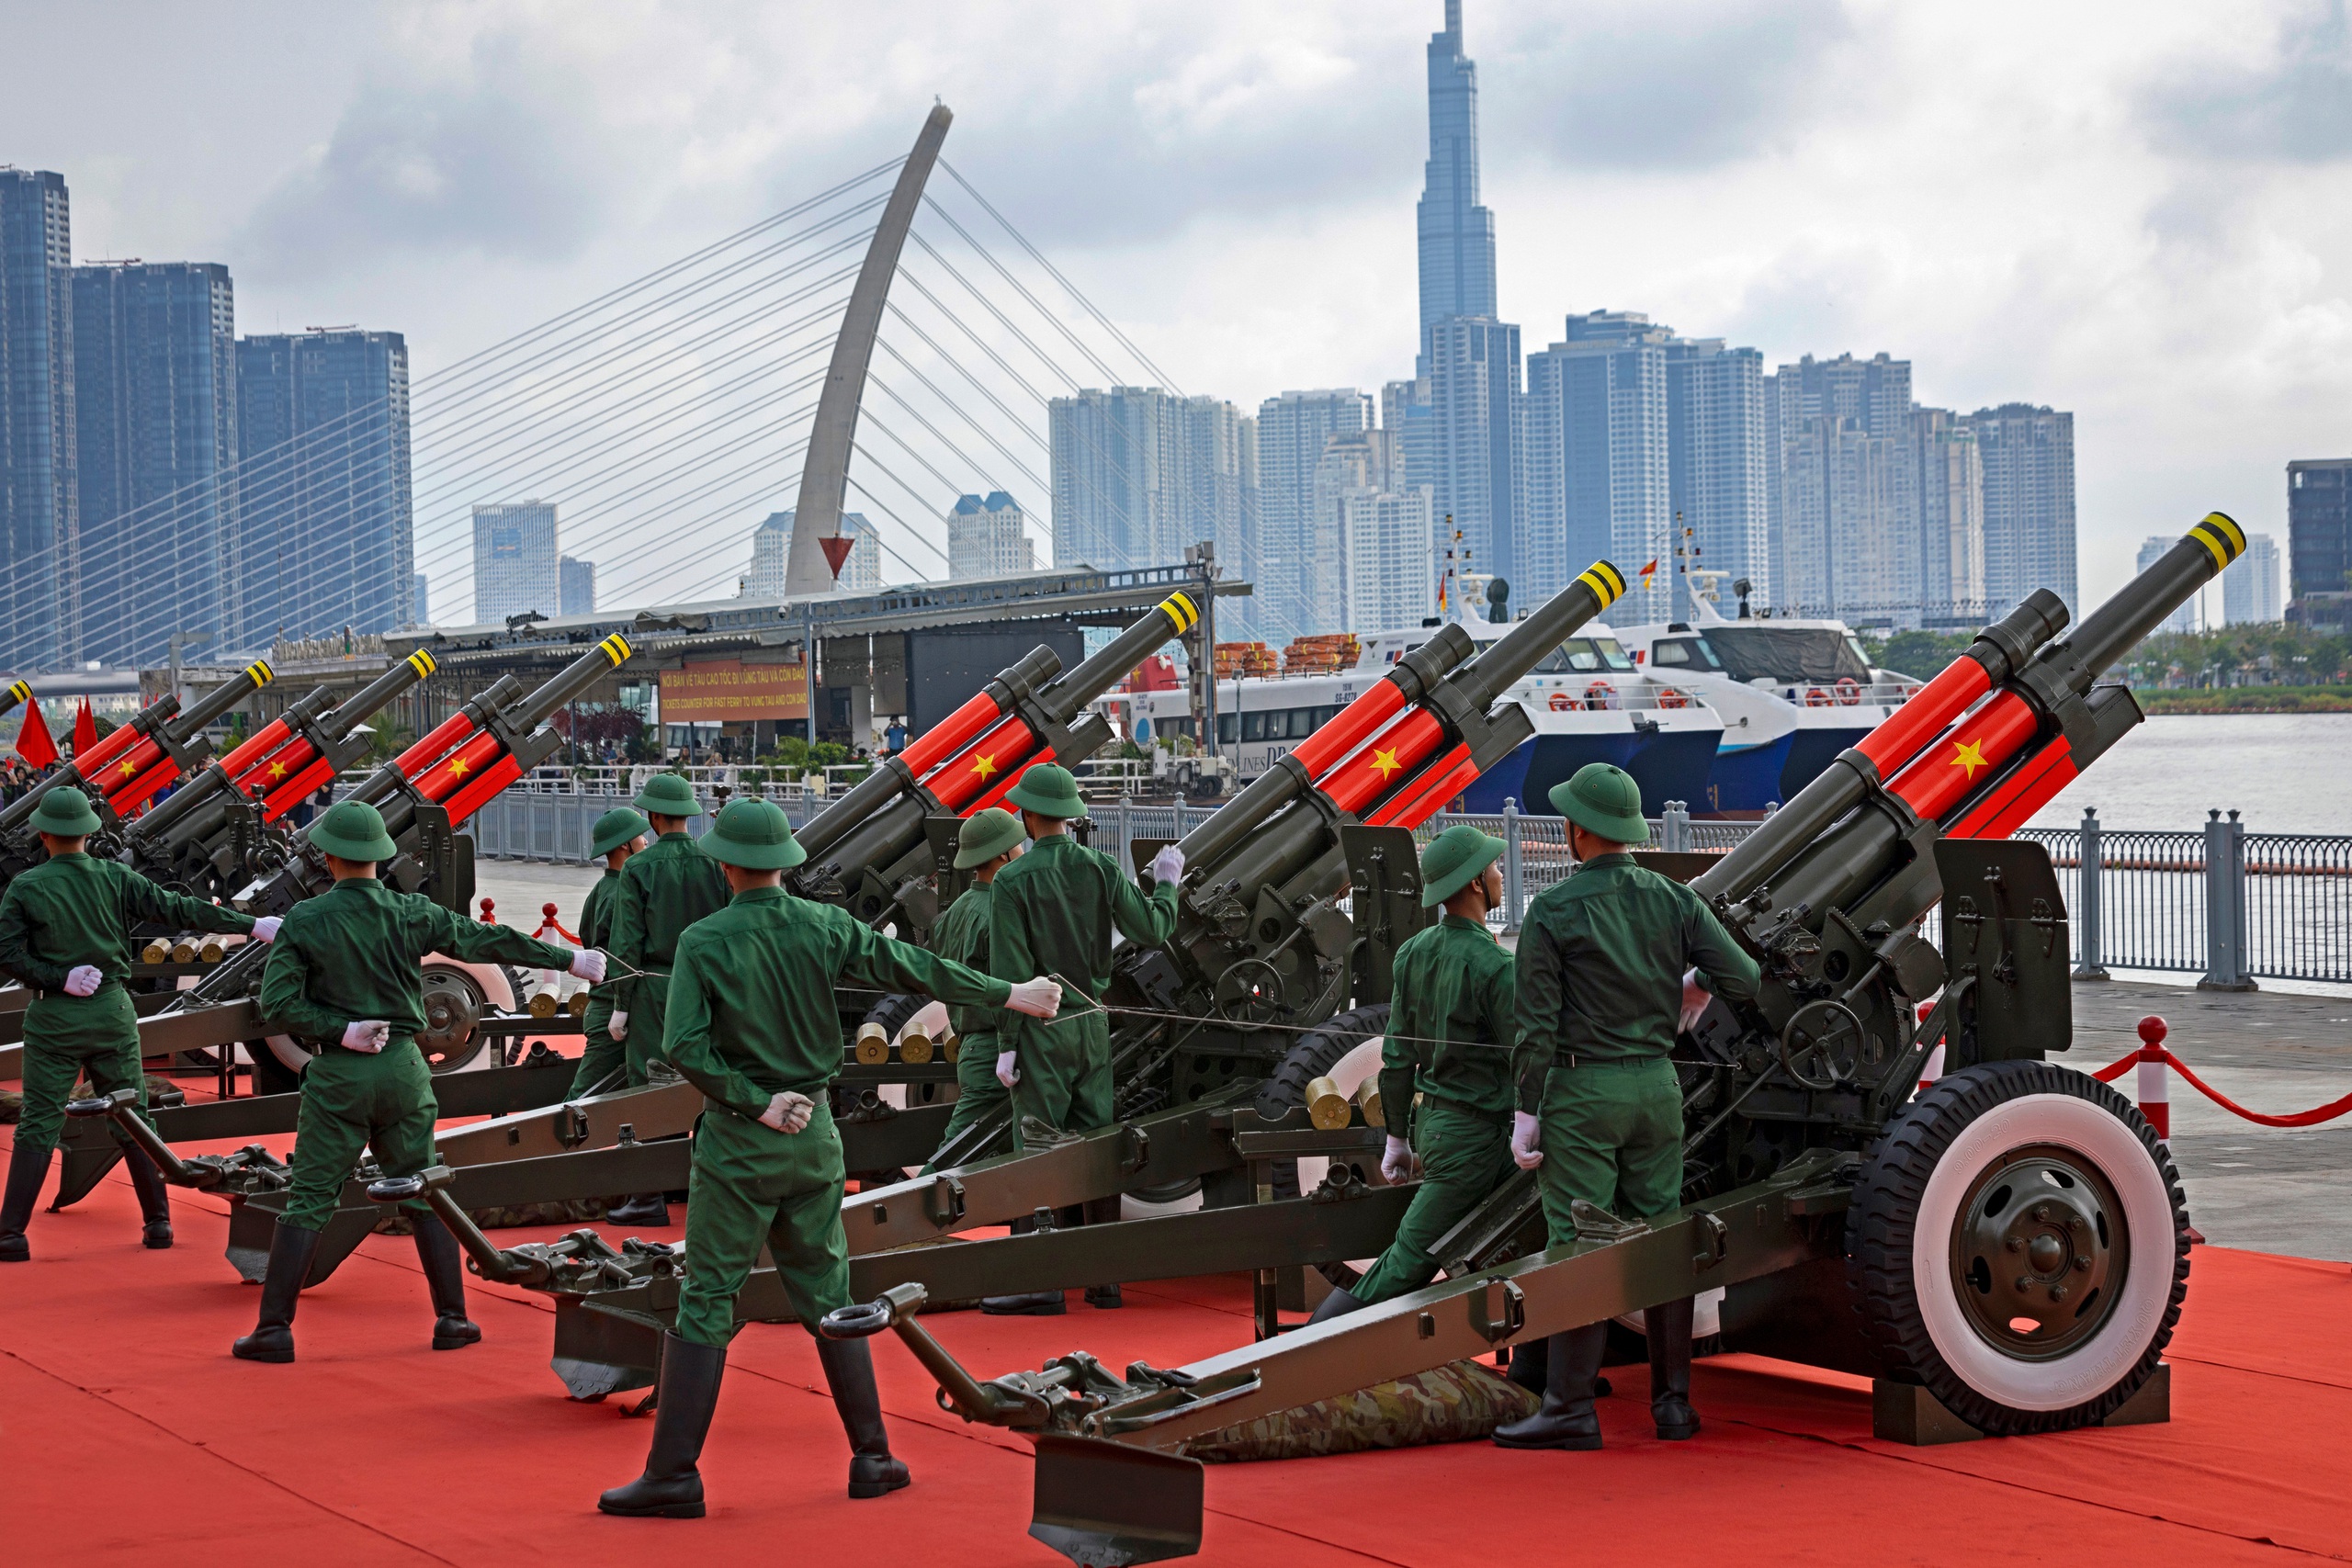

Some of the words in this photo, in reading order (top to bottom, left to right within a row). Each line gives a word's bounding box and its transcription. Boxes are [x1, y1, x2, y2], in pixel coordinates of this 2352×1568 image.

[673, 671, 684, 687] BÁN
[694, 671, 706, 686] TÀU
[707, 672, 718, 685] CAO
[719, 669, 731, 685] TỐC
[757, 667, 769, 683] TÀU
[769, 666, 778, 682] VÀ
[779, 666, 791, 682] CÔN
[662, 699, 680, 709] TICKETS
[681, 698, 702, 708] COUNTER
[704, 697, 713, 707] FOR
[714, 696, 726, 707] FAST
[727, 696, 742, 707] FERRY
[743, 696, 750, 707] TO
[751, 695, 764, 706] VUNG
[764, 695, 775, 706] TAU
[775, 694, 786, 705] AND
[786, 694, 797, 705] CON
[797, 693, 807, 705] DAO
